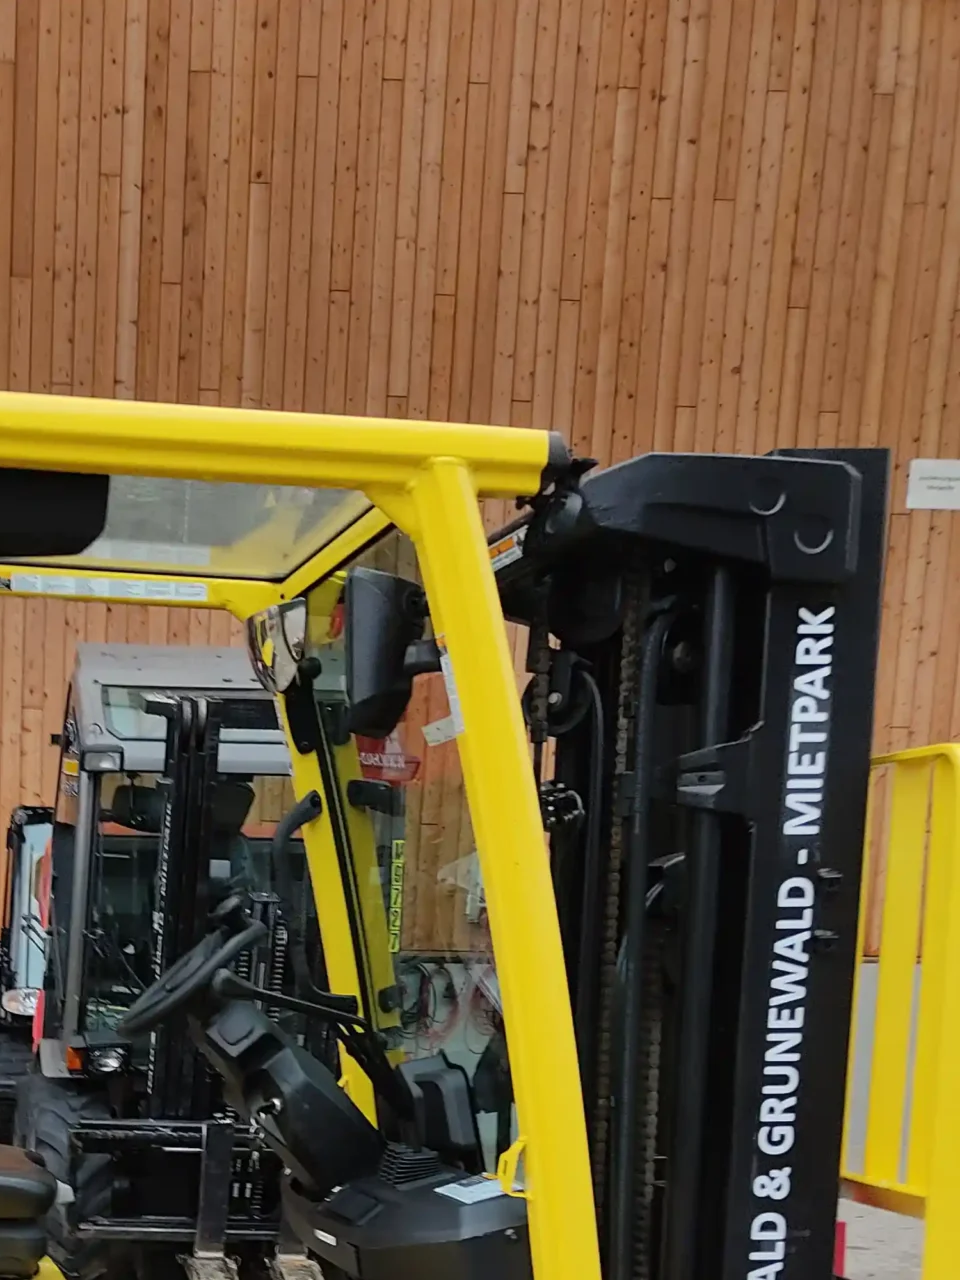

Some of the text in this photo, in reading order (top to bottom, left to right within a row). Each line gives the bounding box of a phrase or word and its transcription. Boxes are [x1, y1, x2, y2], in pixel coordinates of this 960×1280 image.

[782, 606, 835, 836] MIETPARK
[797, 848, 809, 865] -
[757, 876, 815, 1156] GRUNEWALD
[752, 1166, 792, 1200] &
